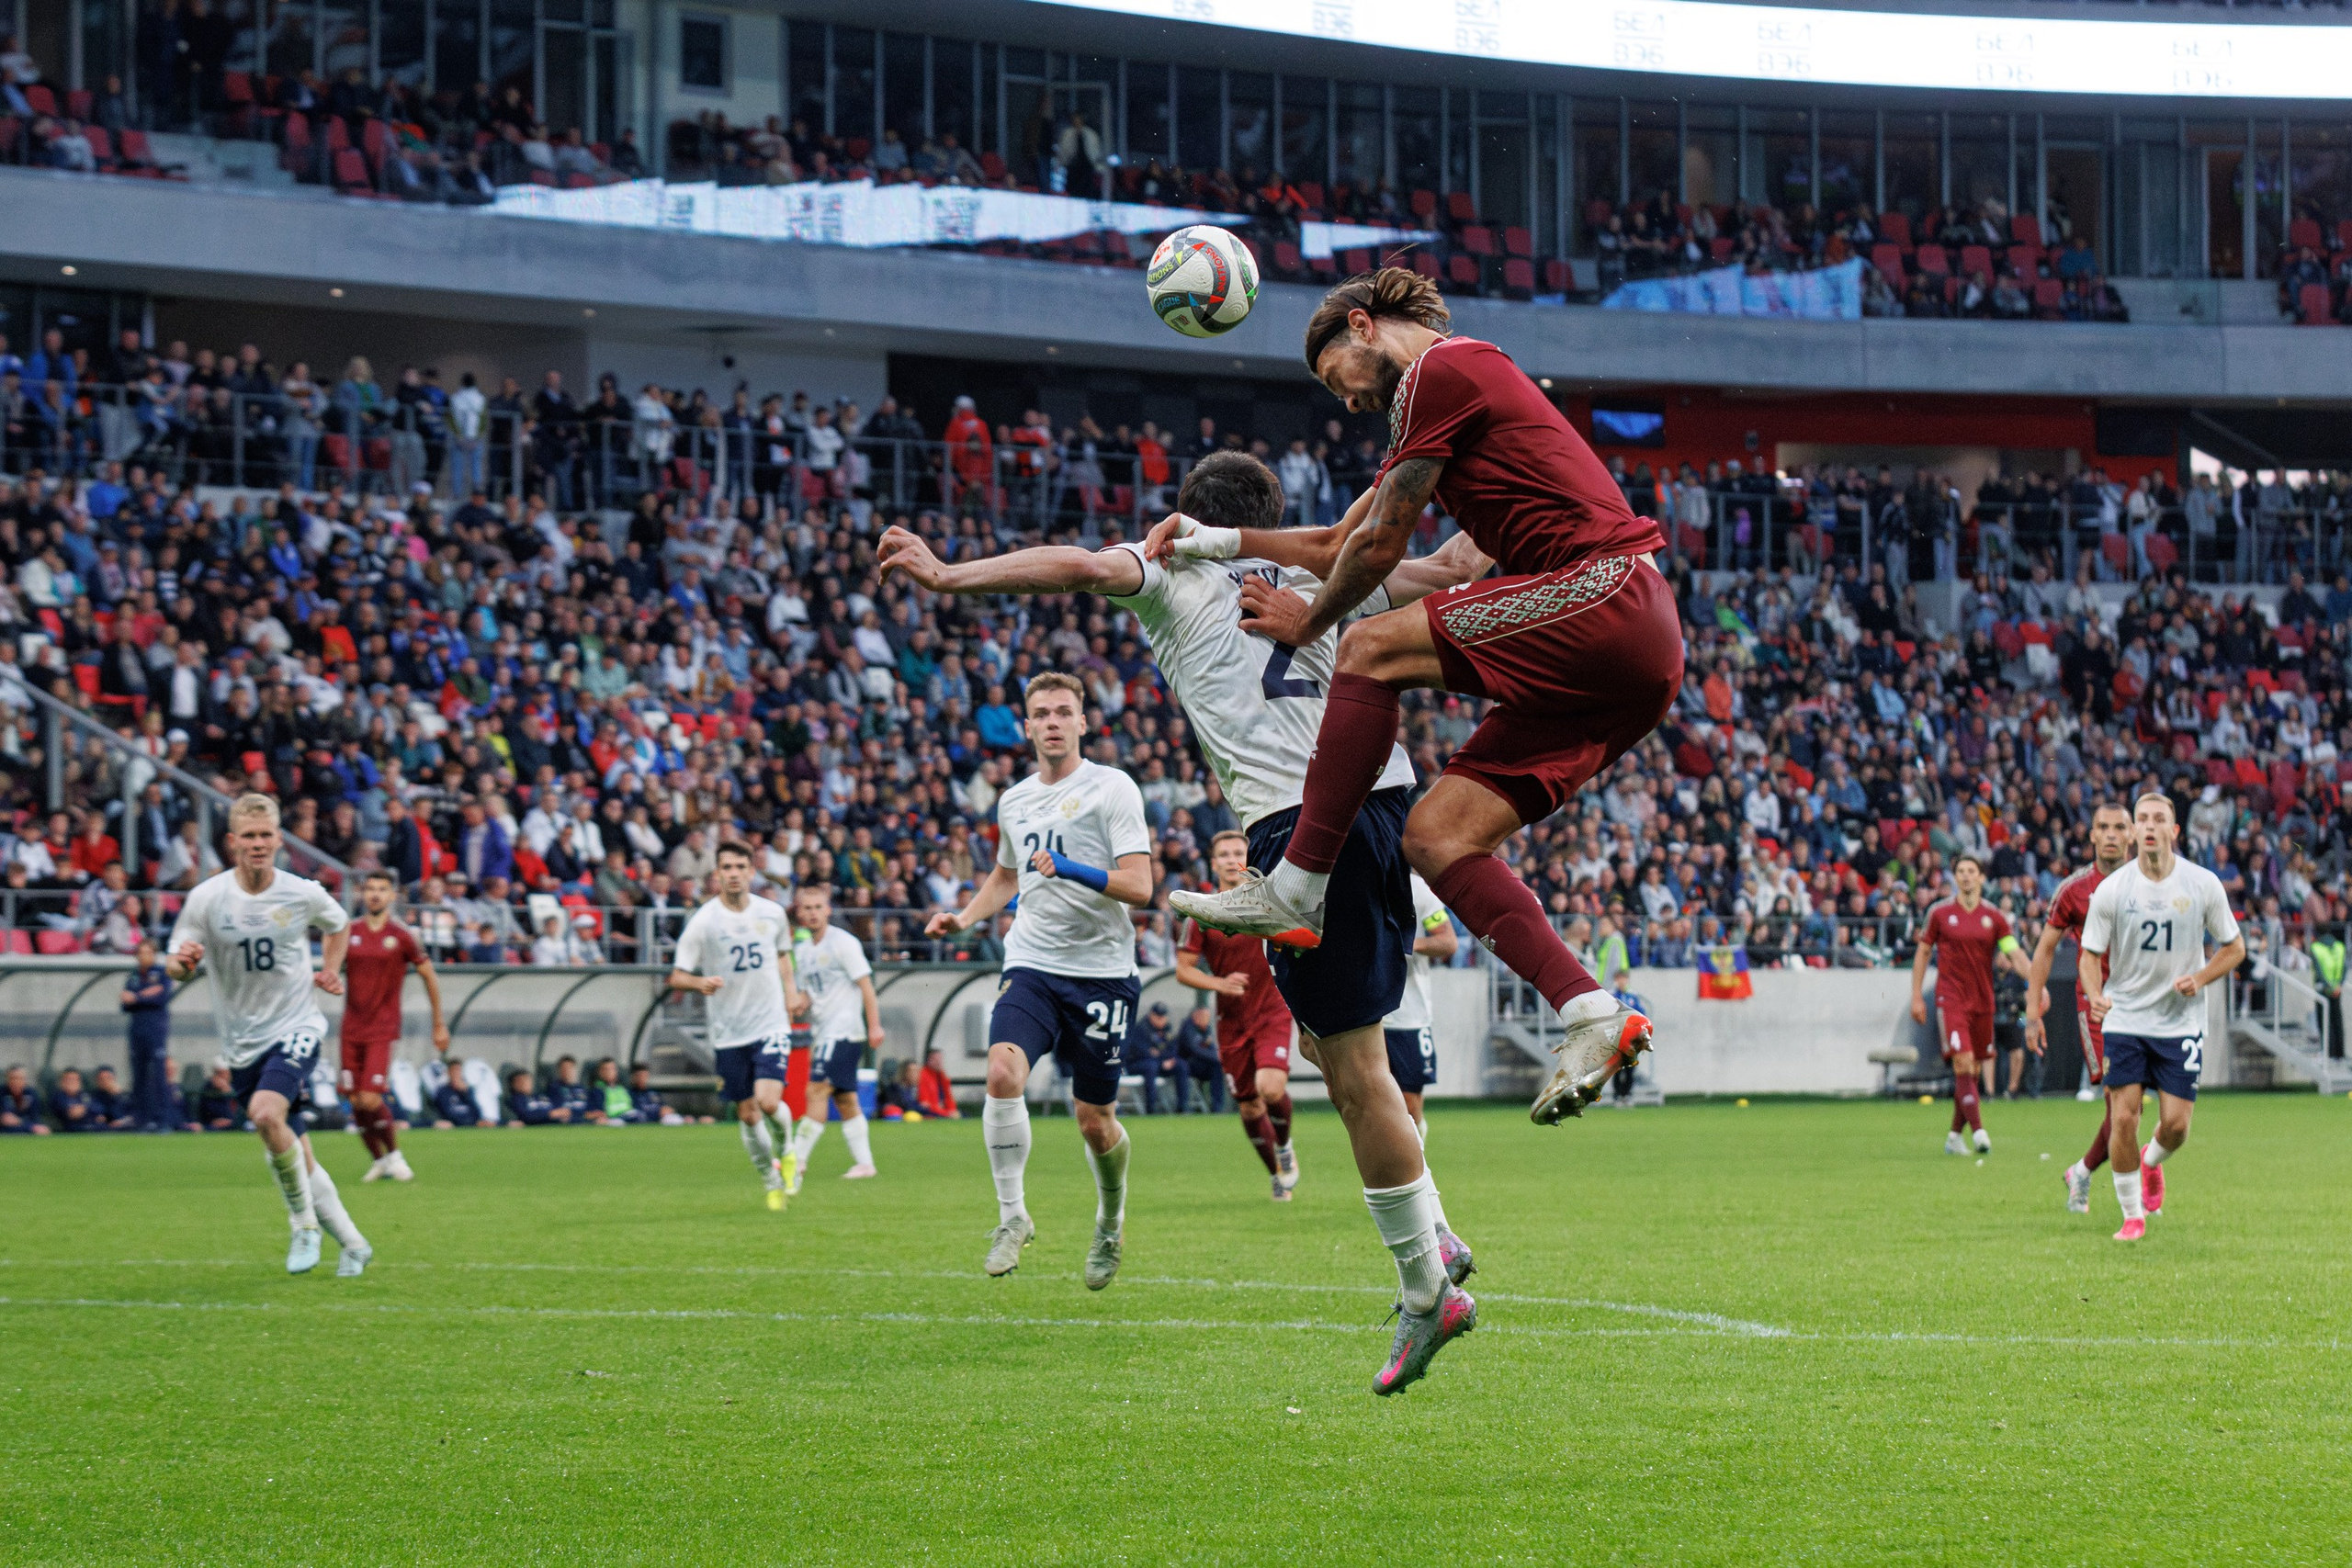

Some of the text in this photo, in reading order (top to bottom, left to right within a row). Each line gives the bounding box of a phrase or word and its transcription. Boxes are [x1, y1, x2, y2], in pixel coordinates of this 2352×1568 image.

[1613, 11, 1667, 33] БЕЛ
[1757, 20, 1812, 42] БЕЛ
[1455, 28, 1501, 52] ВЭБ
[1613, 43, 1665, 66] ВЭБ
[1757, 52, 1812, 75] ВЭБ
[1205, 246, 1227, 293] NATIONS
[1023, 829, 1068, 873] 24
[2141, 919, 2173, 951] 21
[238, 937, 275, 971] 18
[730, 942, 763, 972] 25
[1084, 999, 1128, 1041] 24
[280, 1032, 318, 1058] 18
[762, 1033, 792, 1055] 25
[1418, 1028, 1433, 1056] 6
[1950, 1030, 1962, 1052] 4
[2181, 1038, 2204, 1072] 2
